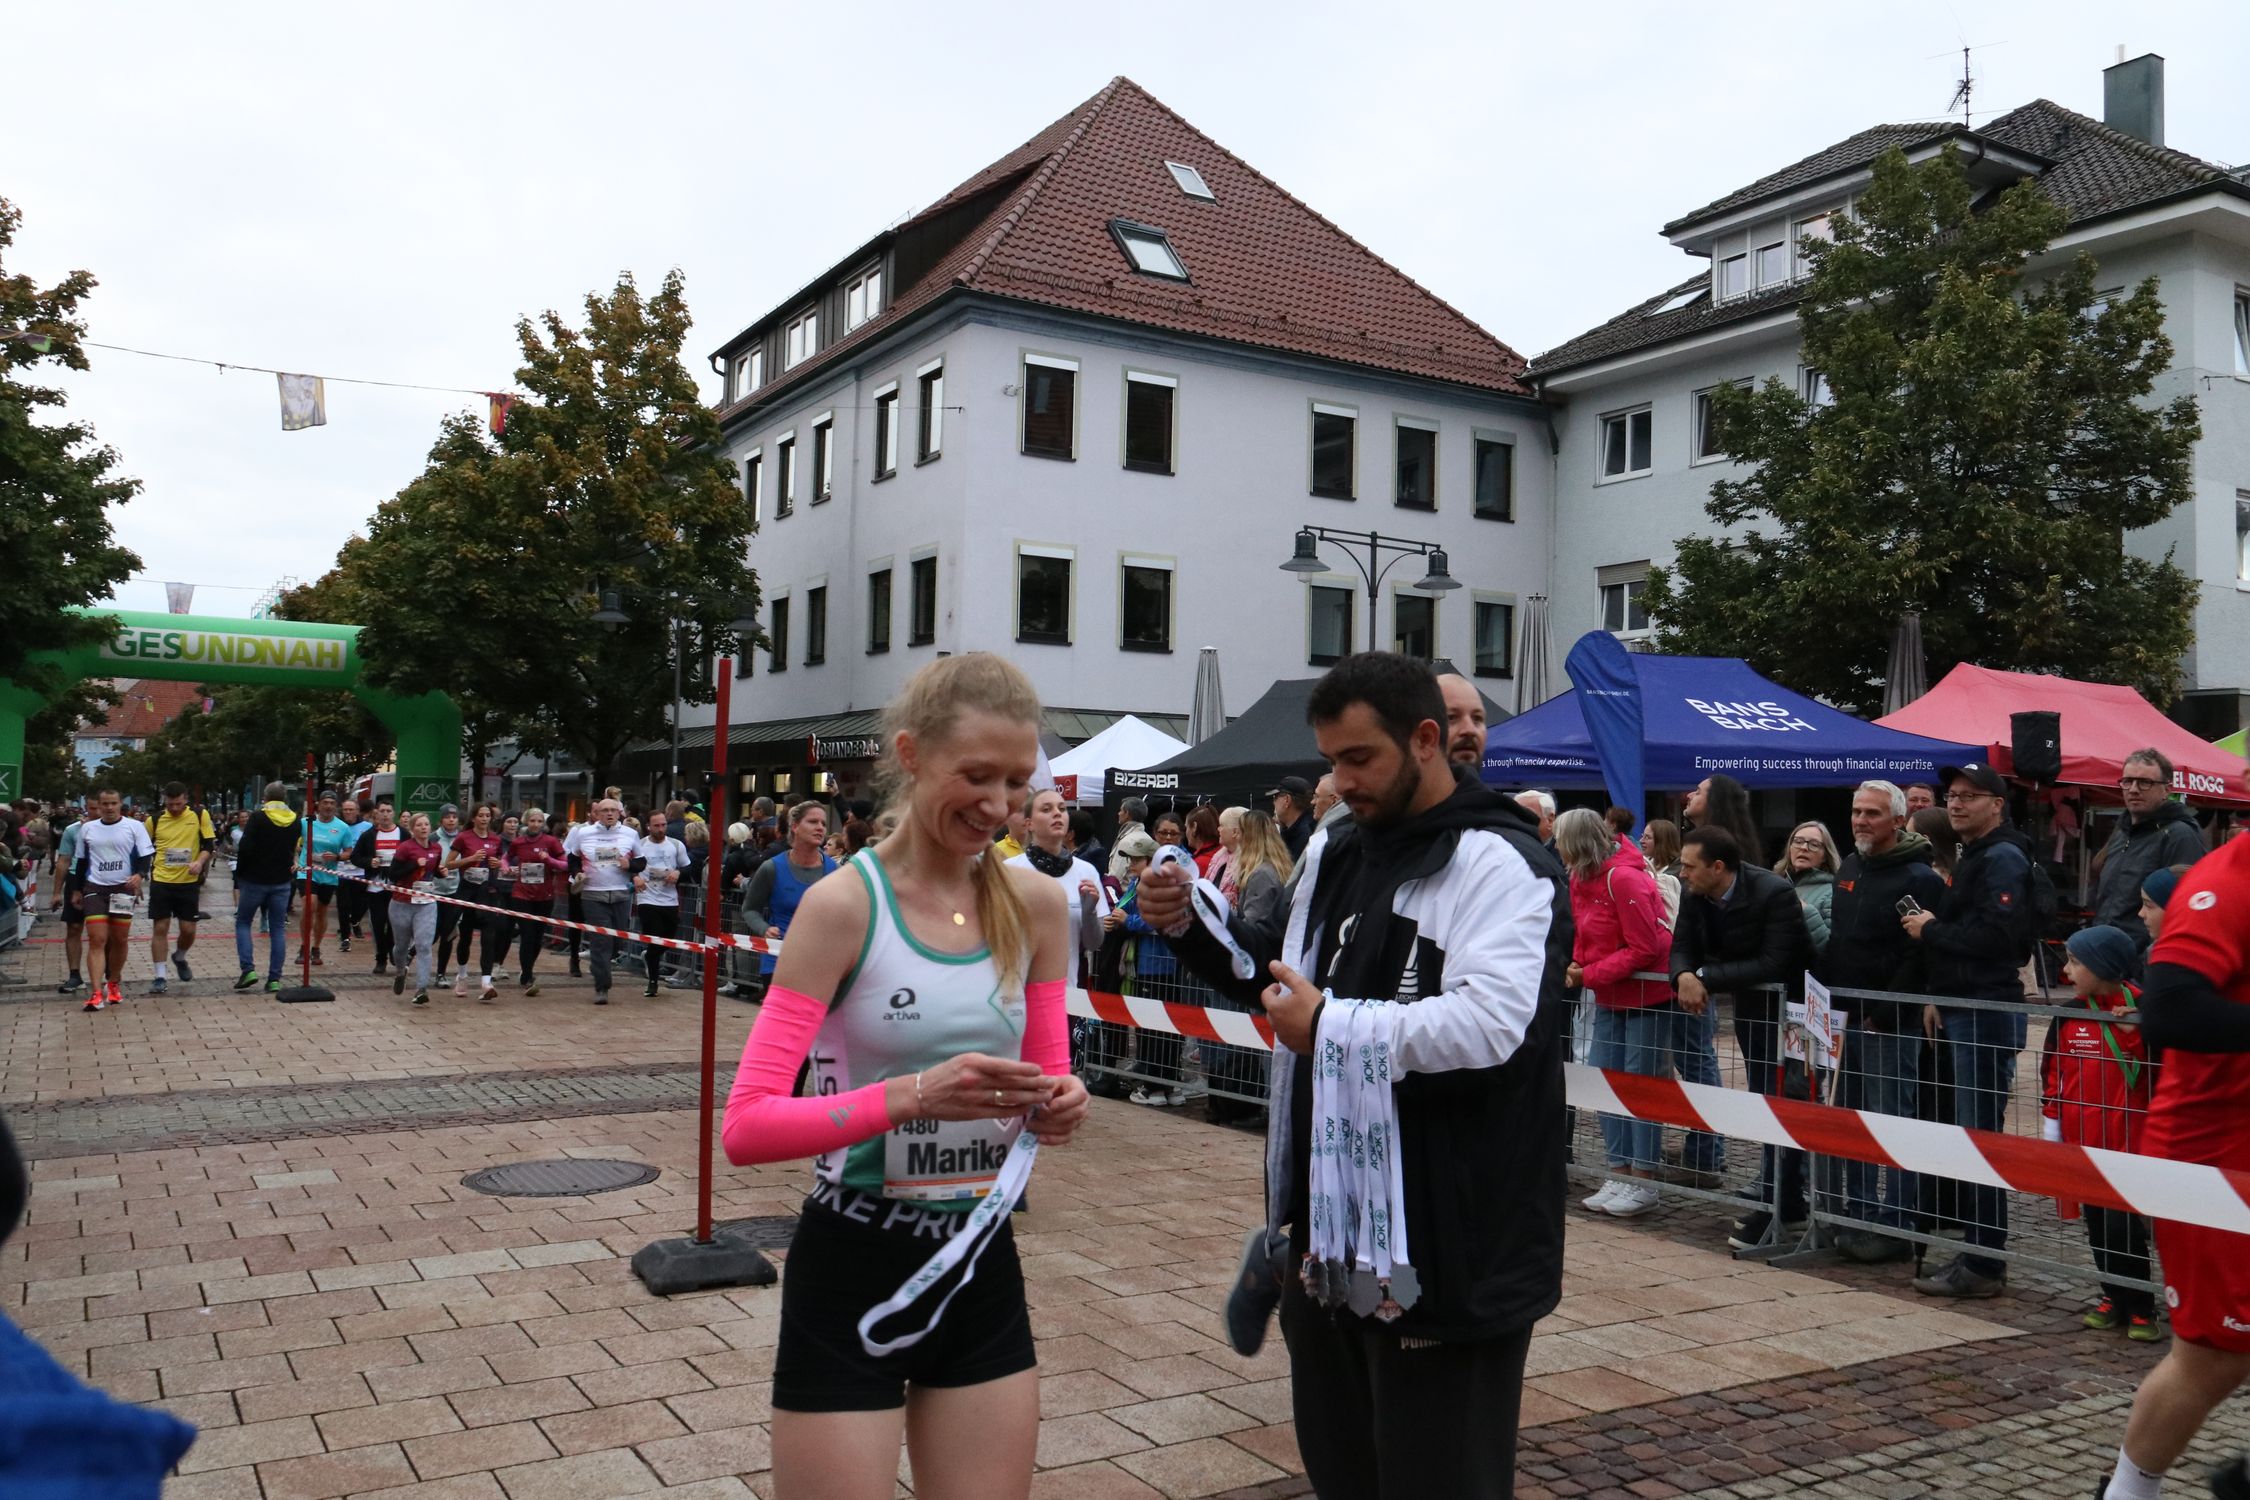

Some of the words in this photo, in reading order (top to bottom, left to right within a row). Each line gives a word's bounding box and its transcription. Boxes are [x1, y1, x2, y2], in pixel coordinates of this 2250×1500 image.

[109, 628, 340, 669] GESUNDNAH
[1685, 698, 1790, 718] BANS
[1708, 715, 1818, 732] BACH
[1487, 758, 1514, 769] through
[1515, 757, 1546, 767] financial
[1547, 757, 1586, 768] expertise.
[1695, 757, 1760, 772] Empowering
[1763, 759, 1802, 770] success
[1805, 758, 1844, 773] through
[1846, 758, 1887, 770] financial
[1889, 758, 1935, 772] expertise.
[409, 783, 453, 800] AOK
[1114, 771, 1179, 789] BIZERBA
[2188, 773, 2225, 794] ROGG
[883, 1010, 921, 1021] artiva
[1326, 1038, 1336, 1063] AOK
[1363, 1059, 1376, 1085] AOK
[1378, 1056, 1389, 1082] AOK
[1325, 1116, 1335, 1142] AOK
[1340, 1116, 1351, 1142] AOK
[1354, 1130, 1364, 1156] AOK
[907, 1139, 1009, 1176] Marika
[1370, 1145, 1380, 1172] AOK
[1377, 1223, 1387, 1251] AOK
